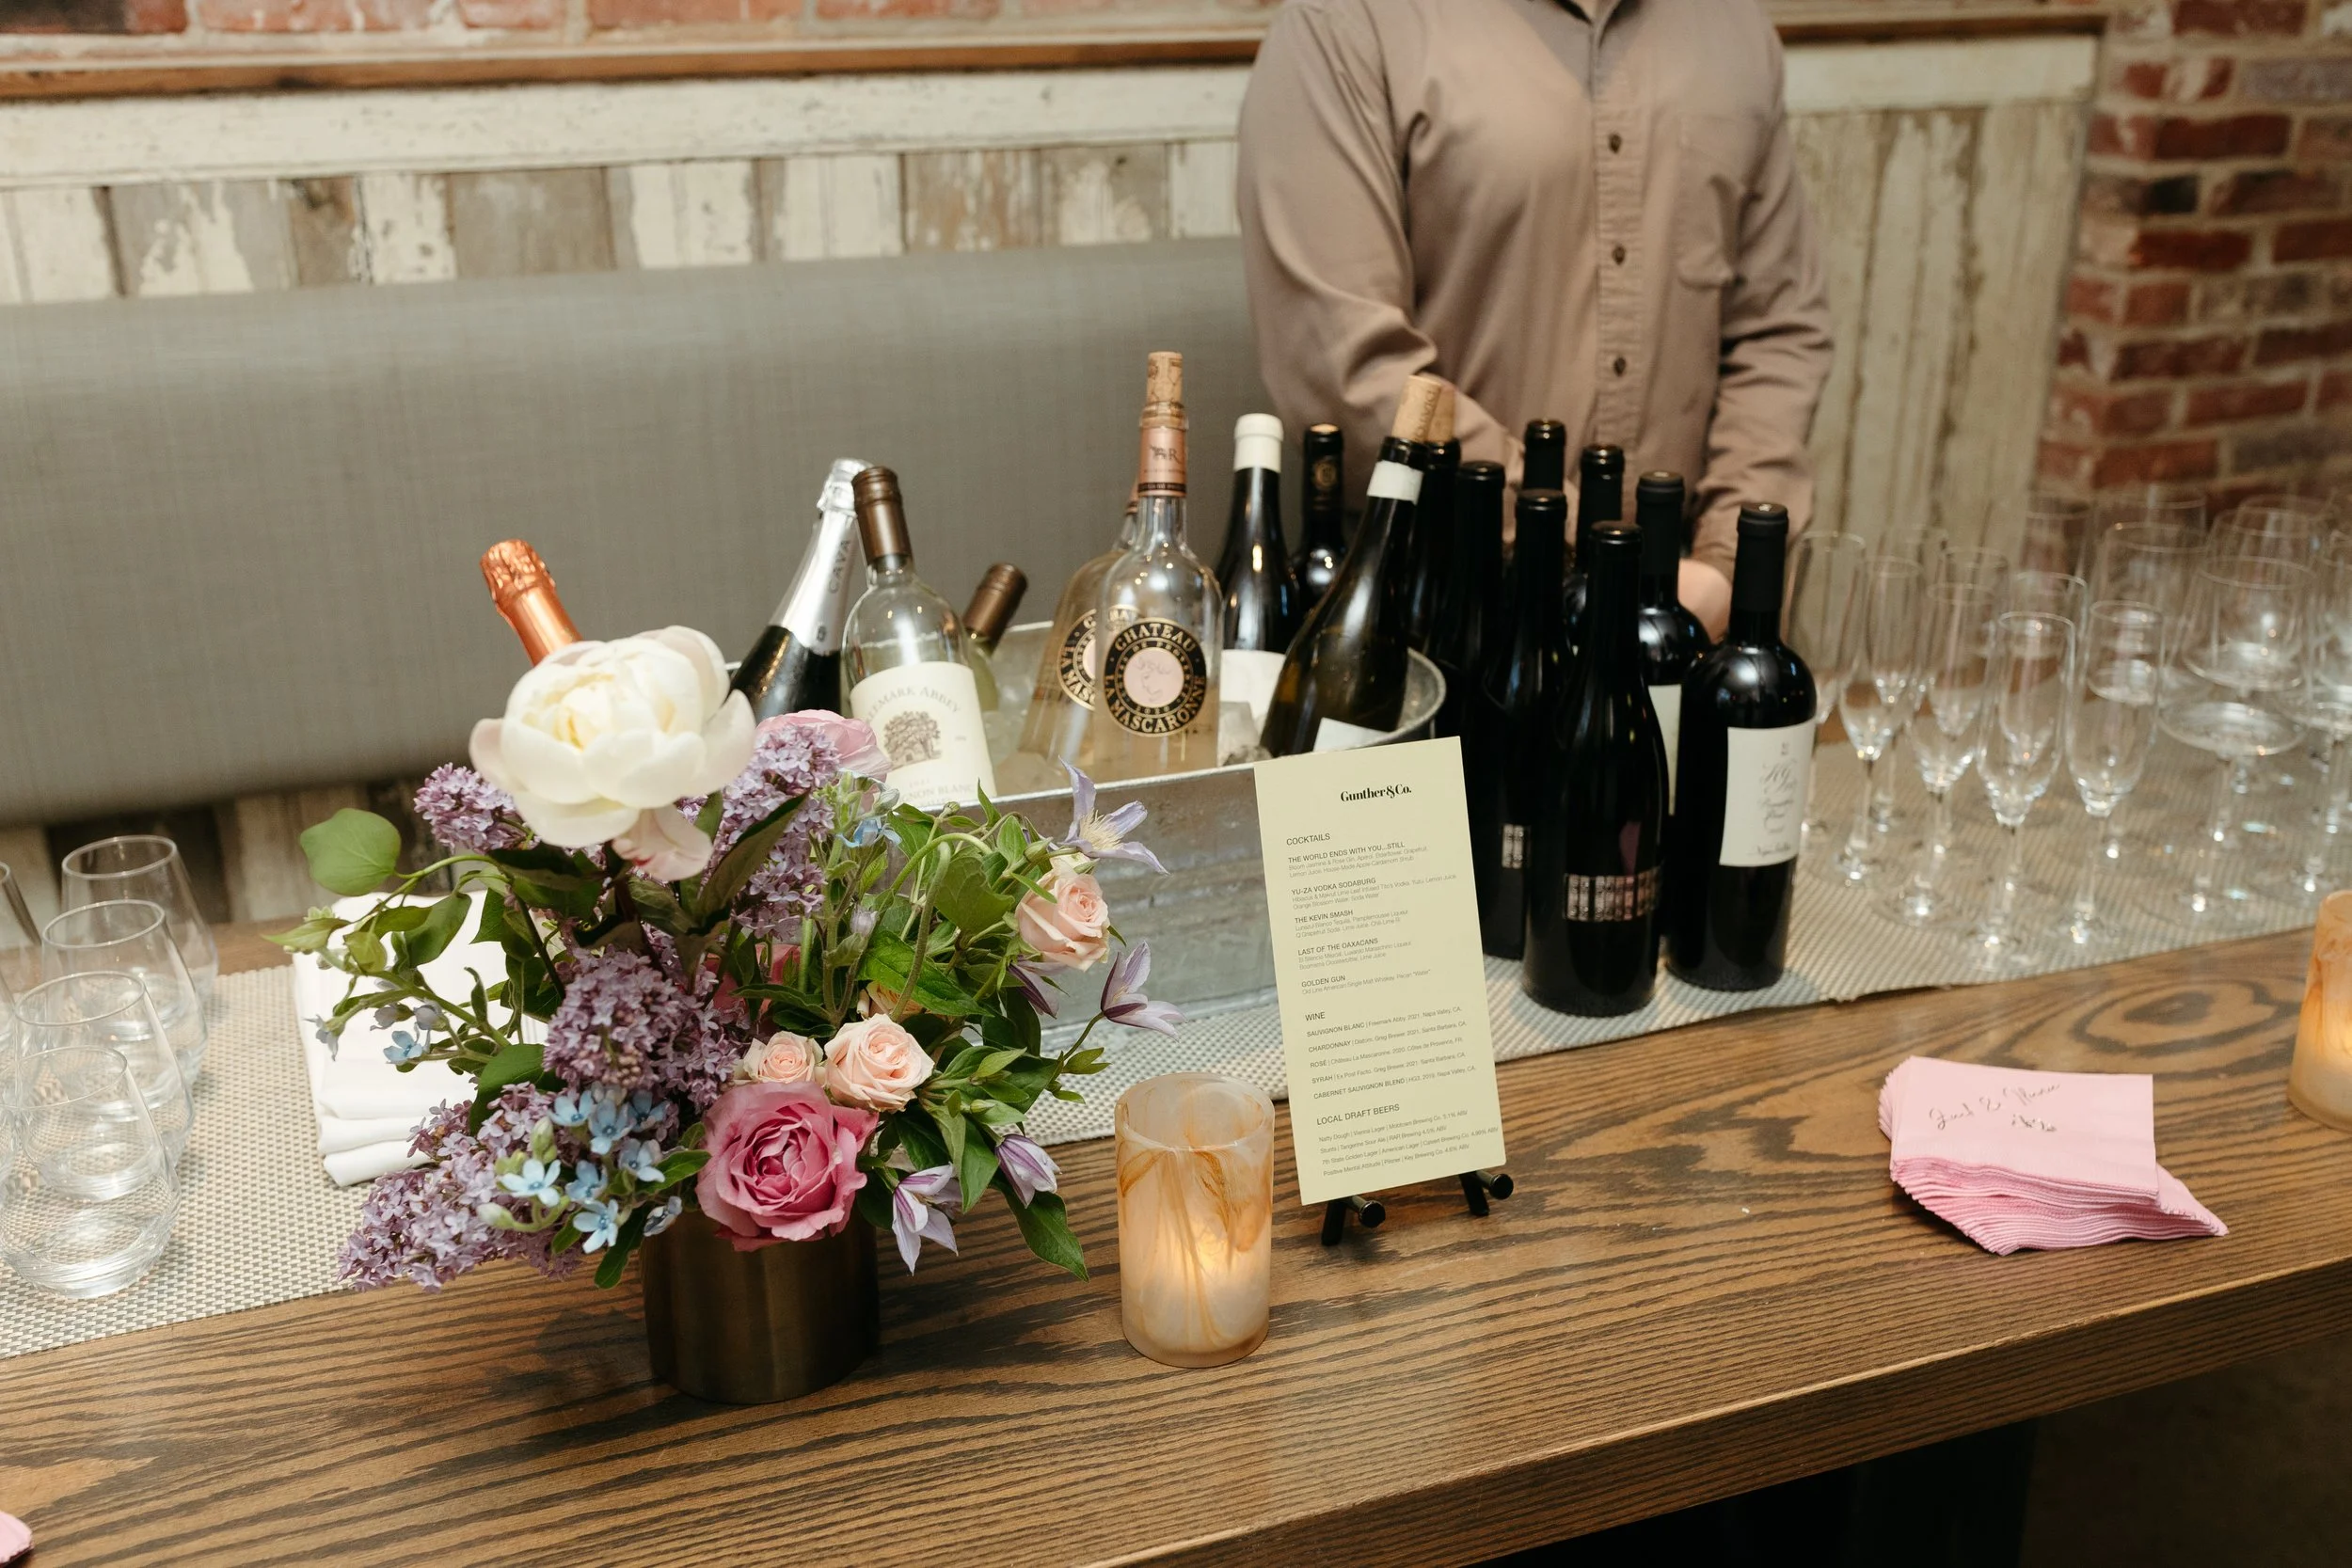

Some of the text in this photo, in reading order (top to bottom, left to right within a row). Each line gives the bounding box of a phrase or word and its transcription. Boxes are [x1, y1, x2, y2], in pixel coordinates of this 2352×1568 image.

[1114, 623, 1198, 652] CHATEAU
[1112, 674, 1206, 734] MASCARONNE
[1341, 784, 1411, 801] Gunther&Co.
[1286, 832, 1330, 846] COCKTAILS
[1302, 852, 1327, 862] WORLD
[1328, 849, 1347, 858] ENDS
[1288, 863, 1305, 871] Bloom
[1306, 860, 1327, 868] Jasmine
[1289, 870, 1307, 879] Lemon
[1291, 878, 1376, 895] YU-ZA VODKA SODABURG
[1292, 894, 1313, 902] Hibiscus
[1311, 898, 1334, 907] Blossom
[1329, 910, 1353, 918] SMASH
[1297, 947, 1314, 956] LAST
[1342, 938, 1378, 949] OAXACANS
[1301, 974, 1345, 988] GOLDEN GUN
[1323, 983, 1346, 991] American
[1305, 1011, 1325, 1022] WINE
[1306, 1026, 1343, 1037] SAUVIGNON
[1343, 1022, 1364, 1031] BLANC
[1368, 1019, 1391, 1027] Freemark
[1308, 1040, 1350, 1053] CHARDONNAY
[1310, 1059, 1327, 1068] ROSÉ
[1311, 1075, 1333, 1084] SYRAH
[1313, 1088, 1346, 1099] CABERNET
[1347, 1082, 1383, 1093] SAUVIGNON
[1385, 1077, 1405, 1086] BLEND
[1316, 1103, 1400, 1125] LOCAL DRAFT BEERS
[1333, 1132, 1350, 1140] Dough
[1412, 1117, 1433, 1125] Brewing
[1401, 1131, 1422, 1139] Brewing
[1381, 1145, 1405, 1153] American
